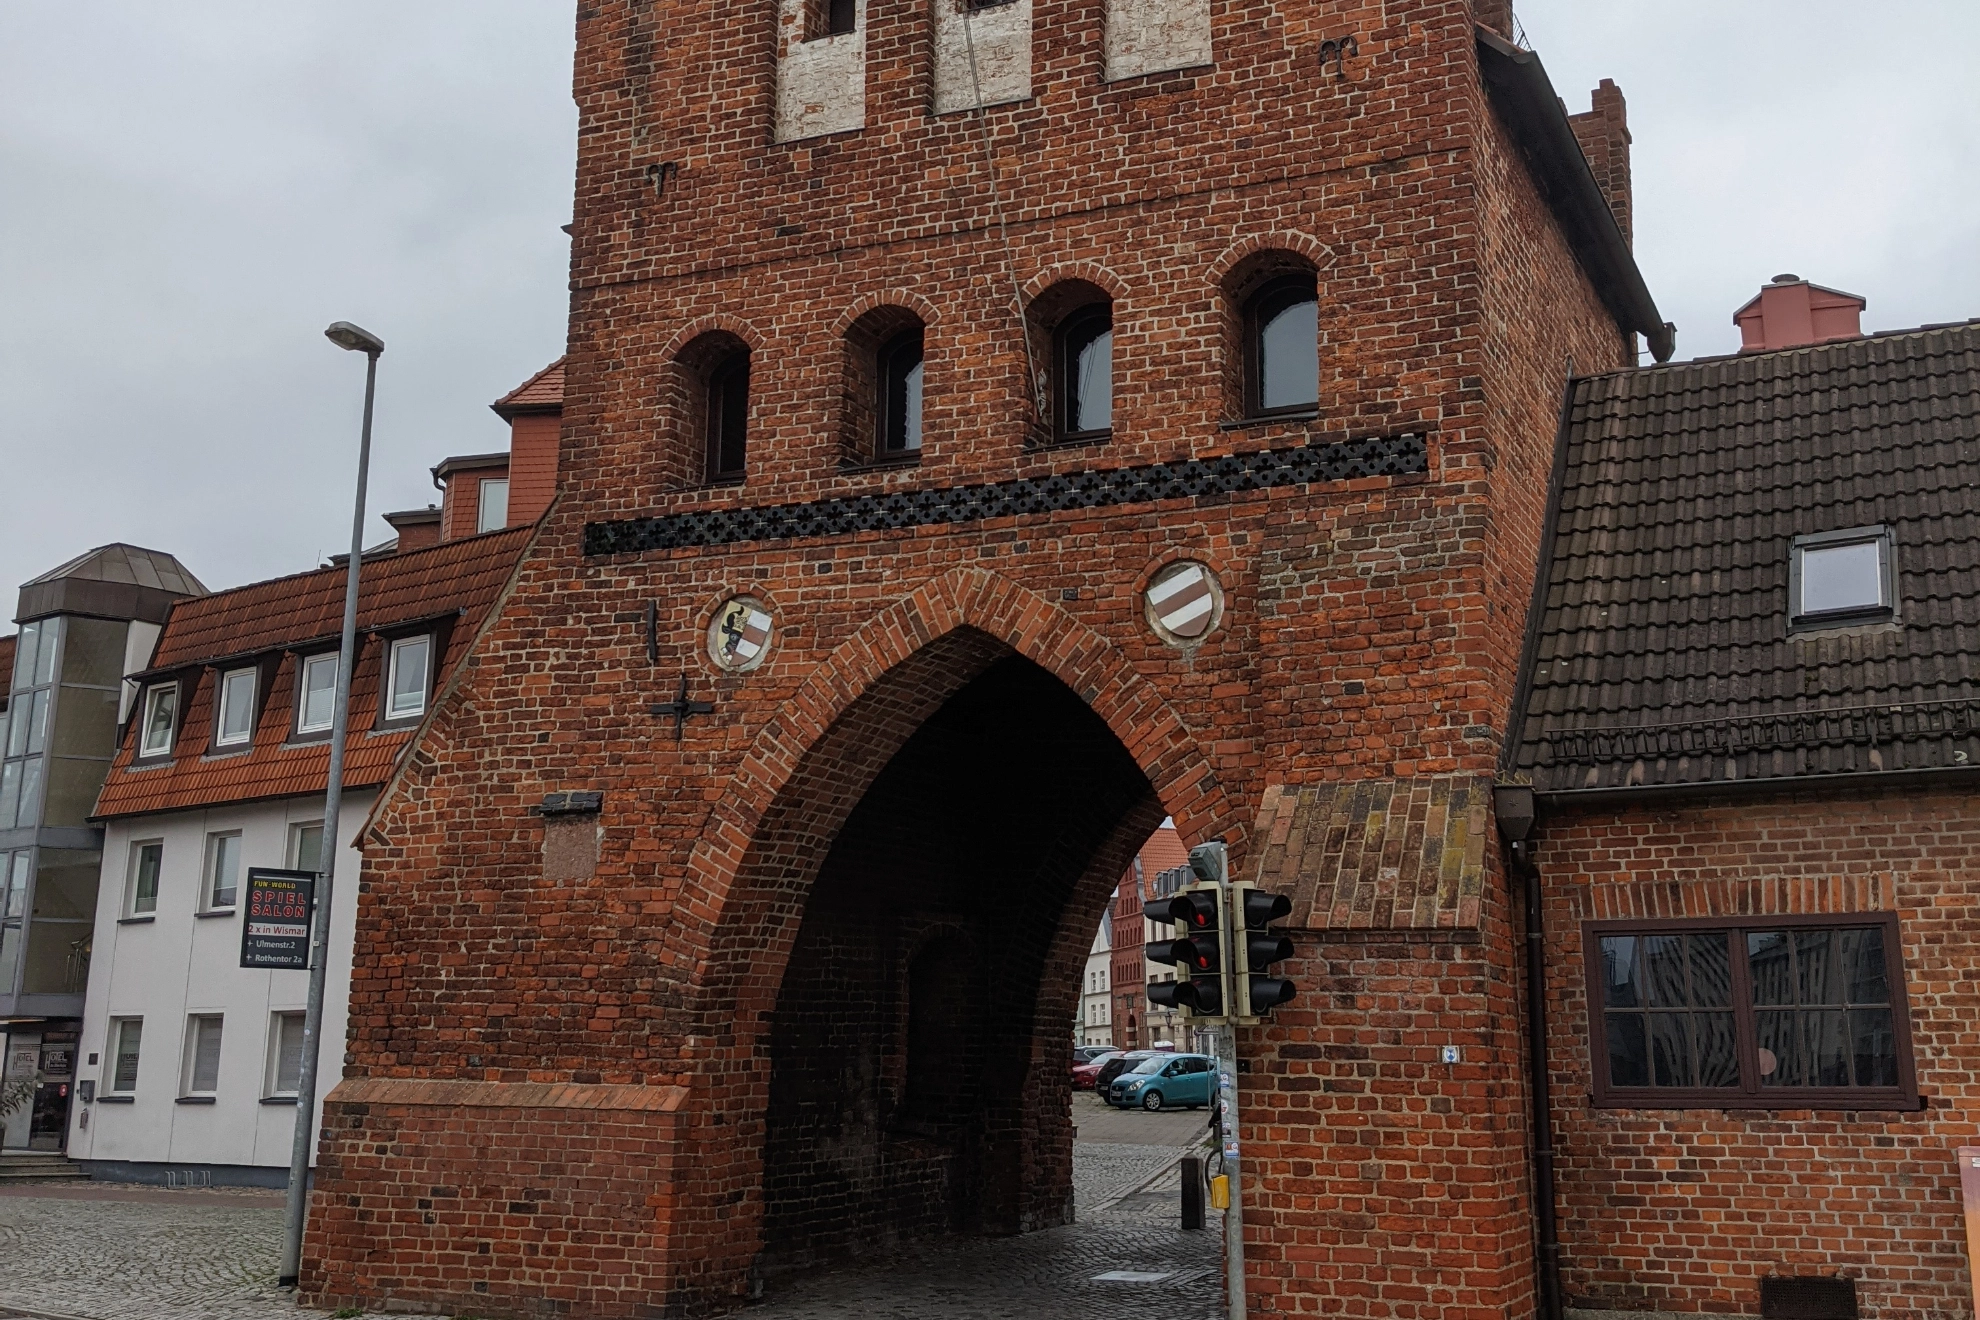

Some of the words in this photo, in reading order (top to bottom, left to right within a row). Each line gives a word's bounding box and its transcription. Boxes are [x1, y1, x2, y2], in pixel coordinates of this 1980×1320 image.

[253, 890, 306, 904] SPIEL
[251, 904, 305, 917] SALON
[248, 925, 254, 933] 2
[262, 925, 271, 934] in
[273, 926, 305, 935] Wismar
[256, 940, 296, 949] Ulmenstr.2
[255, 954, 292, 963] Rothentor
